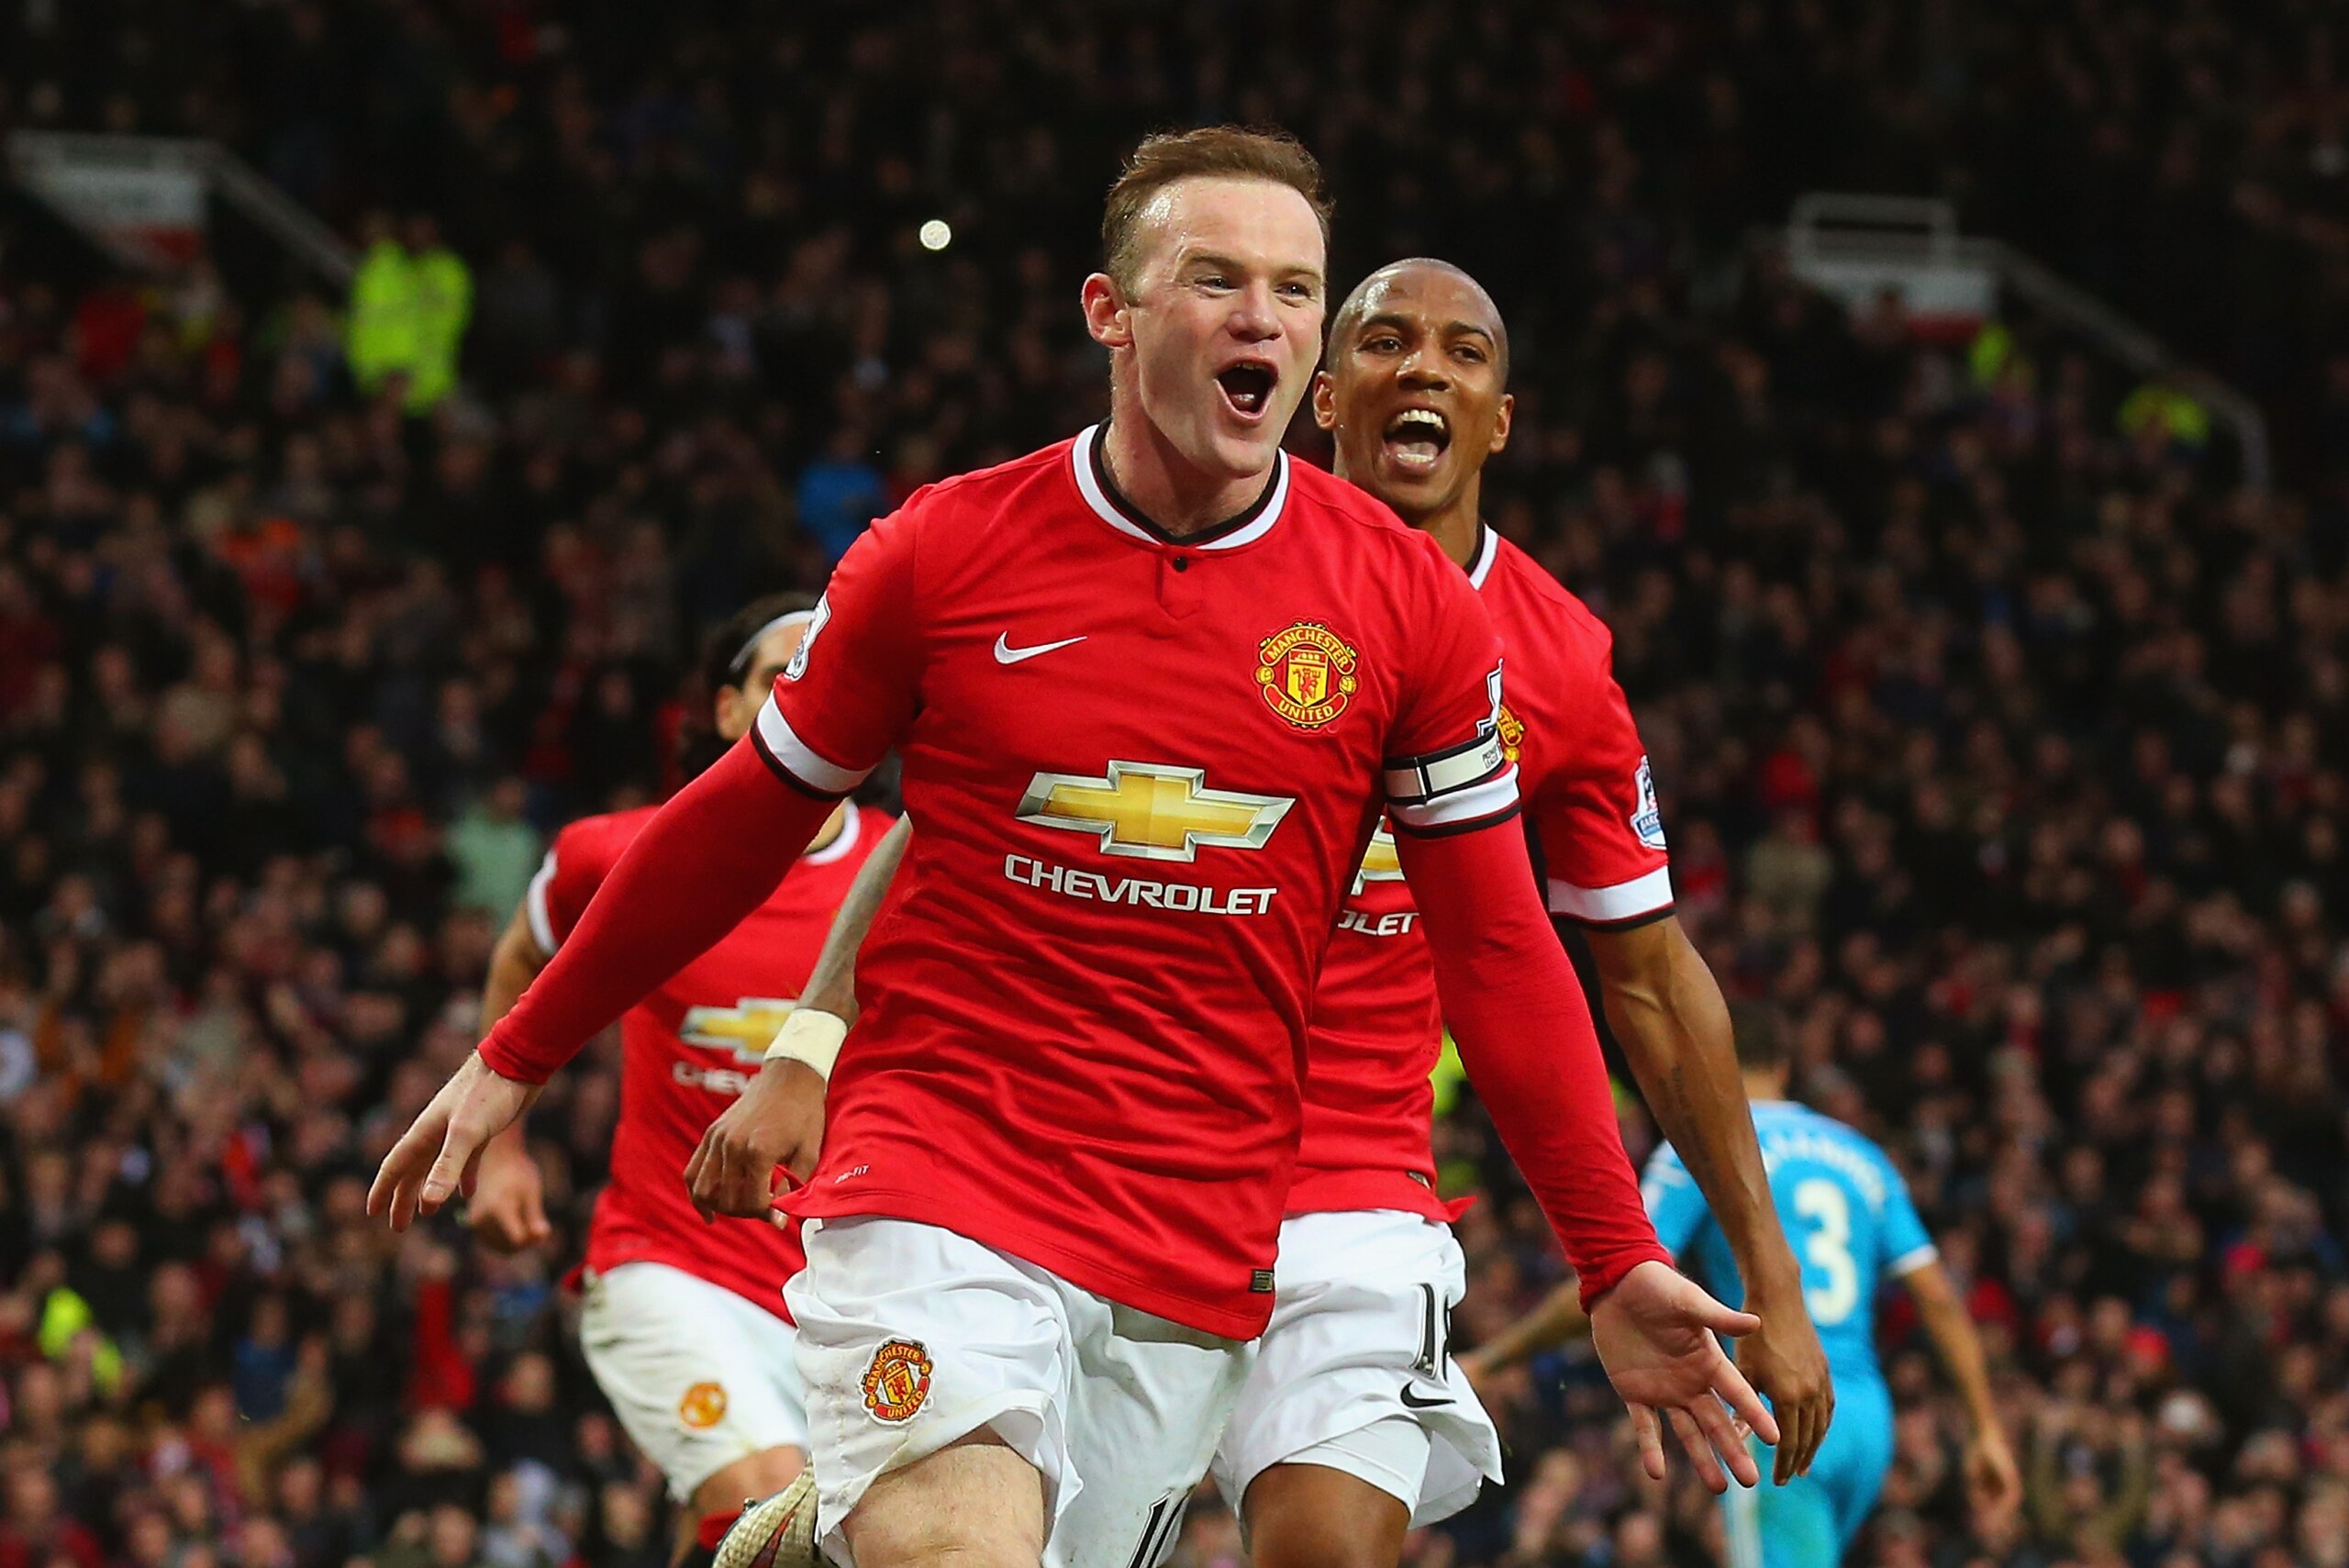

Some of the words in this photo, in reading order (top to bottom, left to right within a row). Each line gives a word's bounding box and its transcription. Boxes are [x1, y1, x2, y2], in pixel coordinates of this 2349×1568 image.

[1267, 629, 1350, 668] MANCHESTER
[1278, 700, 1334, 721] UNITED
[1005, 853, 1277, 915] CHEVROLET
[1794, 1177, 1859, 1328] 3
[1411, 1283, 1449, 1385] 1
[866, 1346, 920, 1386] MANCHESTER
[886, 1390, 923, 1418] UNITED
